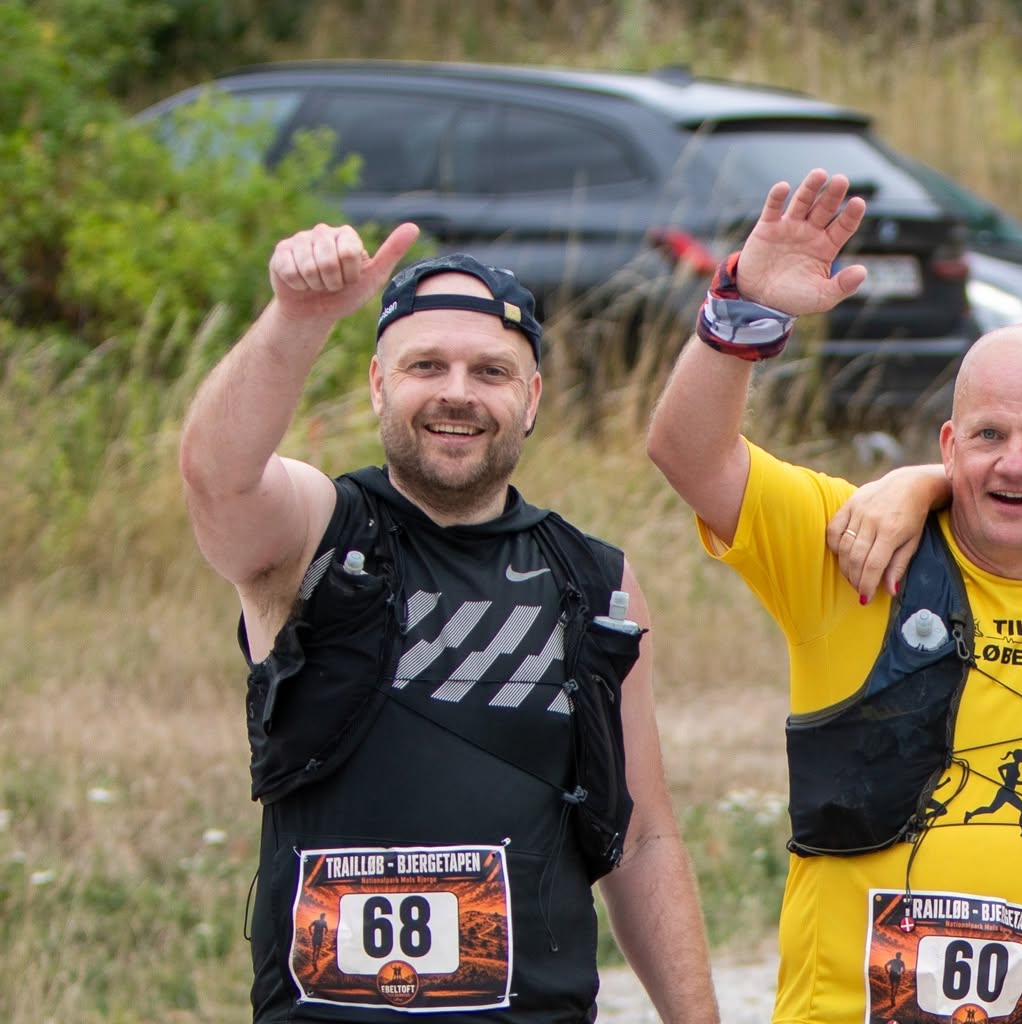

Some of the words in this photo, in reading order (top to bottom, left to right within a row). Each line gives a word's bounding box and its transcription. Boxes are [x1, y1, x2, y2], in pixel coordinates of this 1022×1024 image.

[326, 855, 384, 878] TRAILLØB
[397, 853, 480, 874] BJERGETAPEN
[363, 896, 431, 958] 68
[381, 984, 415, 994] EBELTOFT
[942, 939, 1008, 1003] 60
